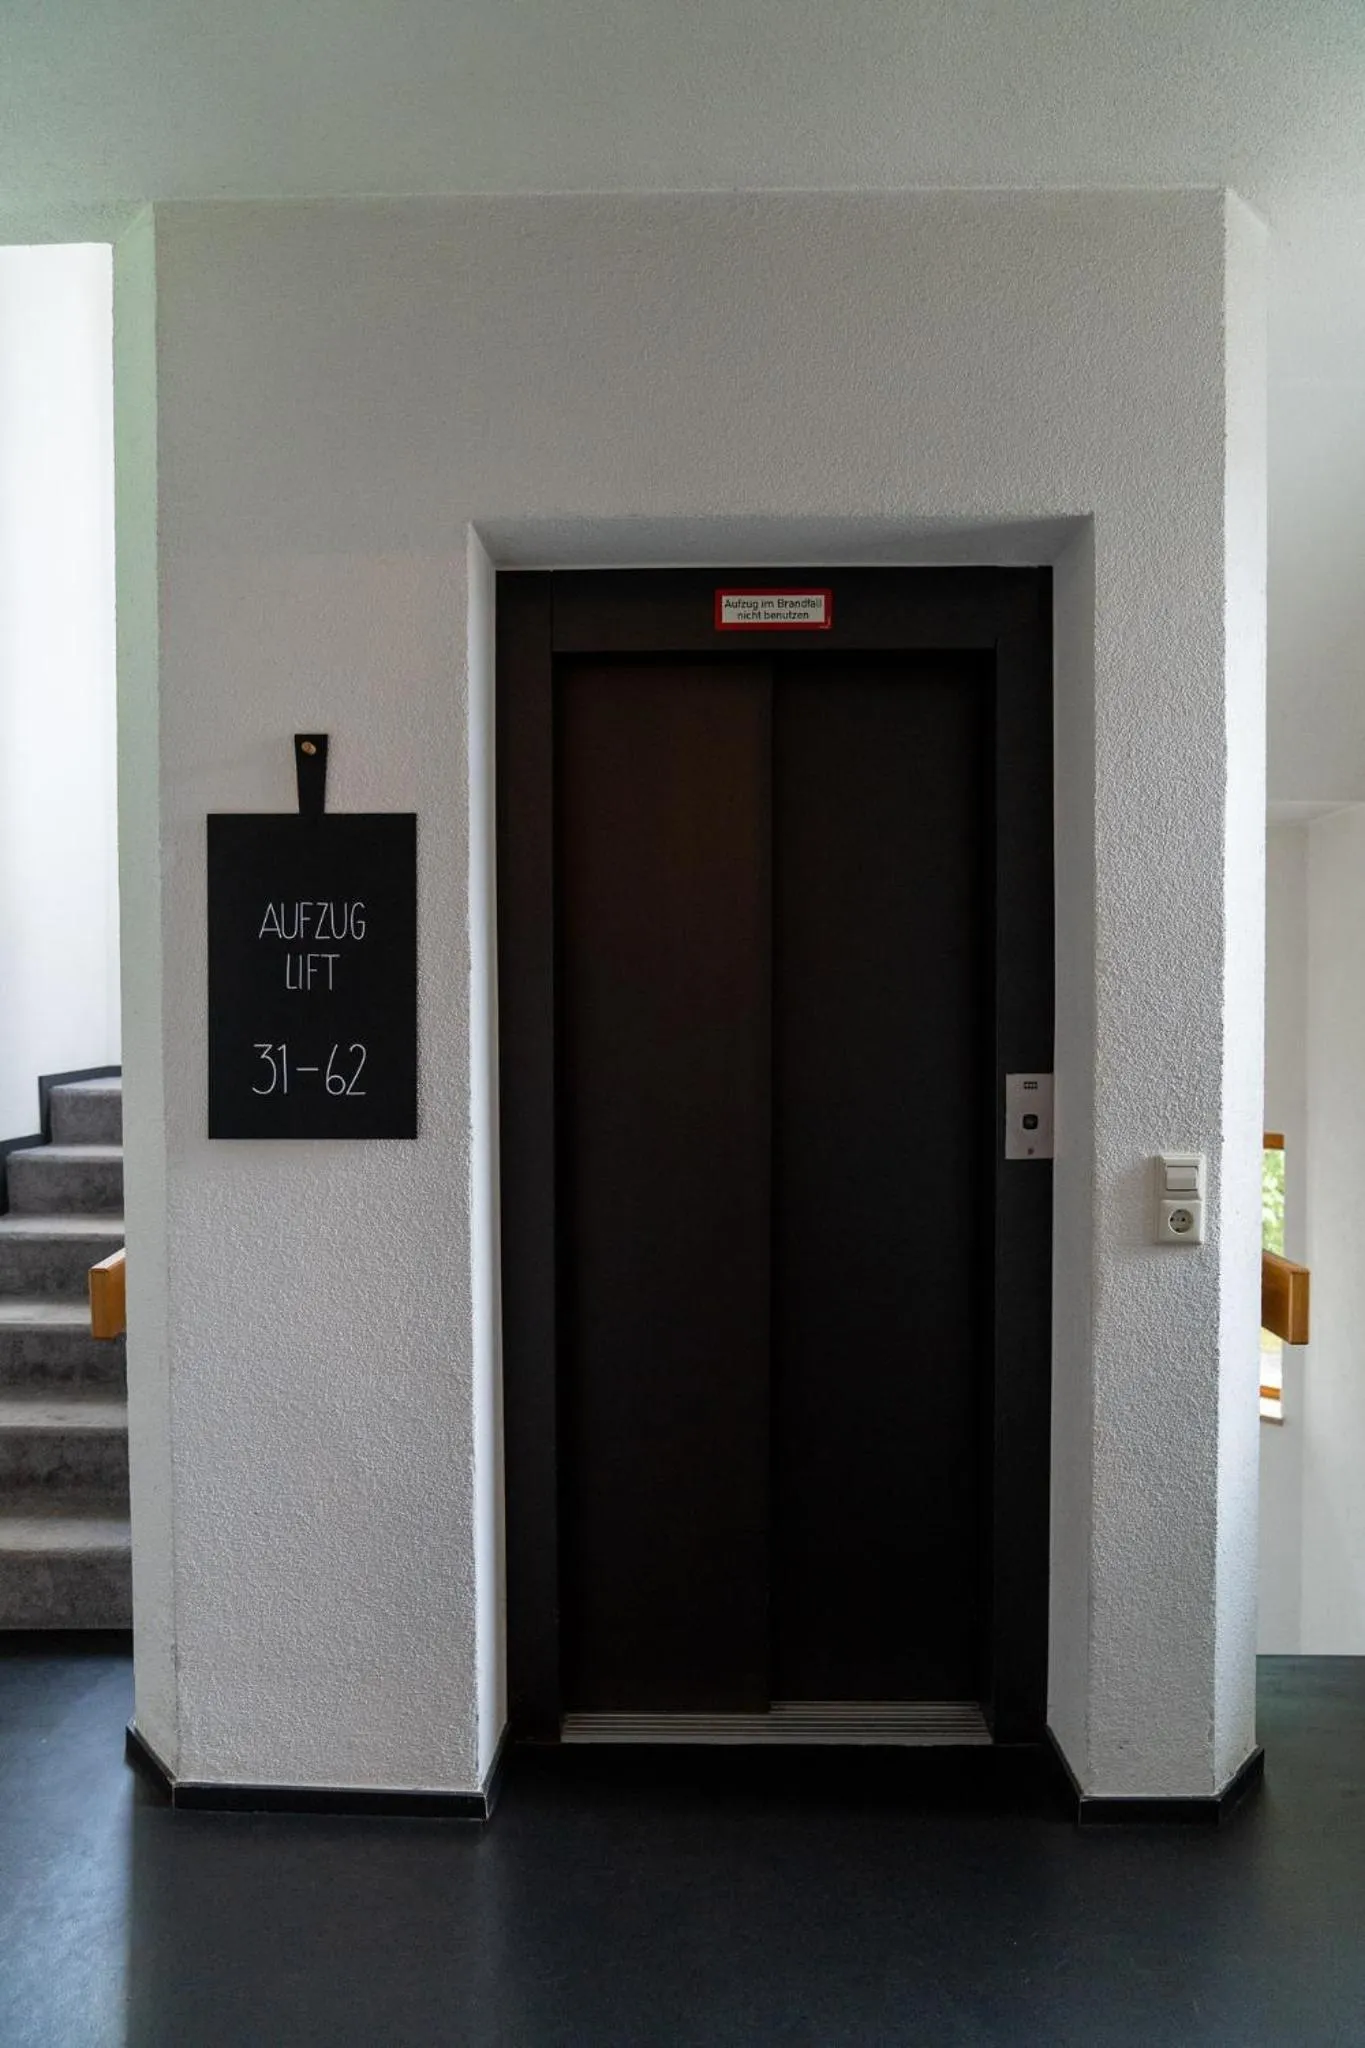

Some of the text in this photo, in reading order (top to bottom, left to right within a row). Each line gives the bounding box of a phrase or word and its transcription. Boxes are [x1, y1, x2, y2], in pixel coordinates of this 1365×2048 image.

[724, 599, 822, 611] Aufzug im Brandfall
[737, 611, 809, 620] nicht benutzen
[258, 901, 366, 941] AUFZUG
[285, 953, 340, 990] LIFT
